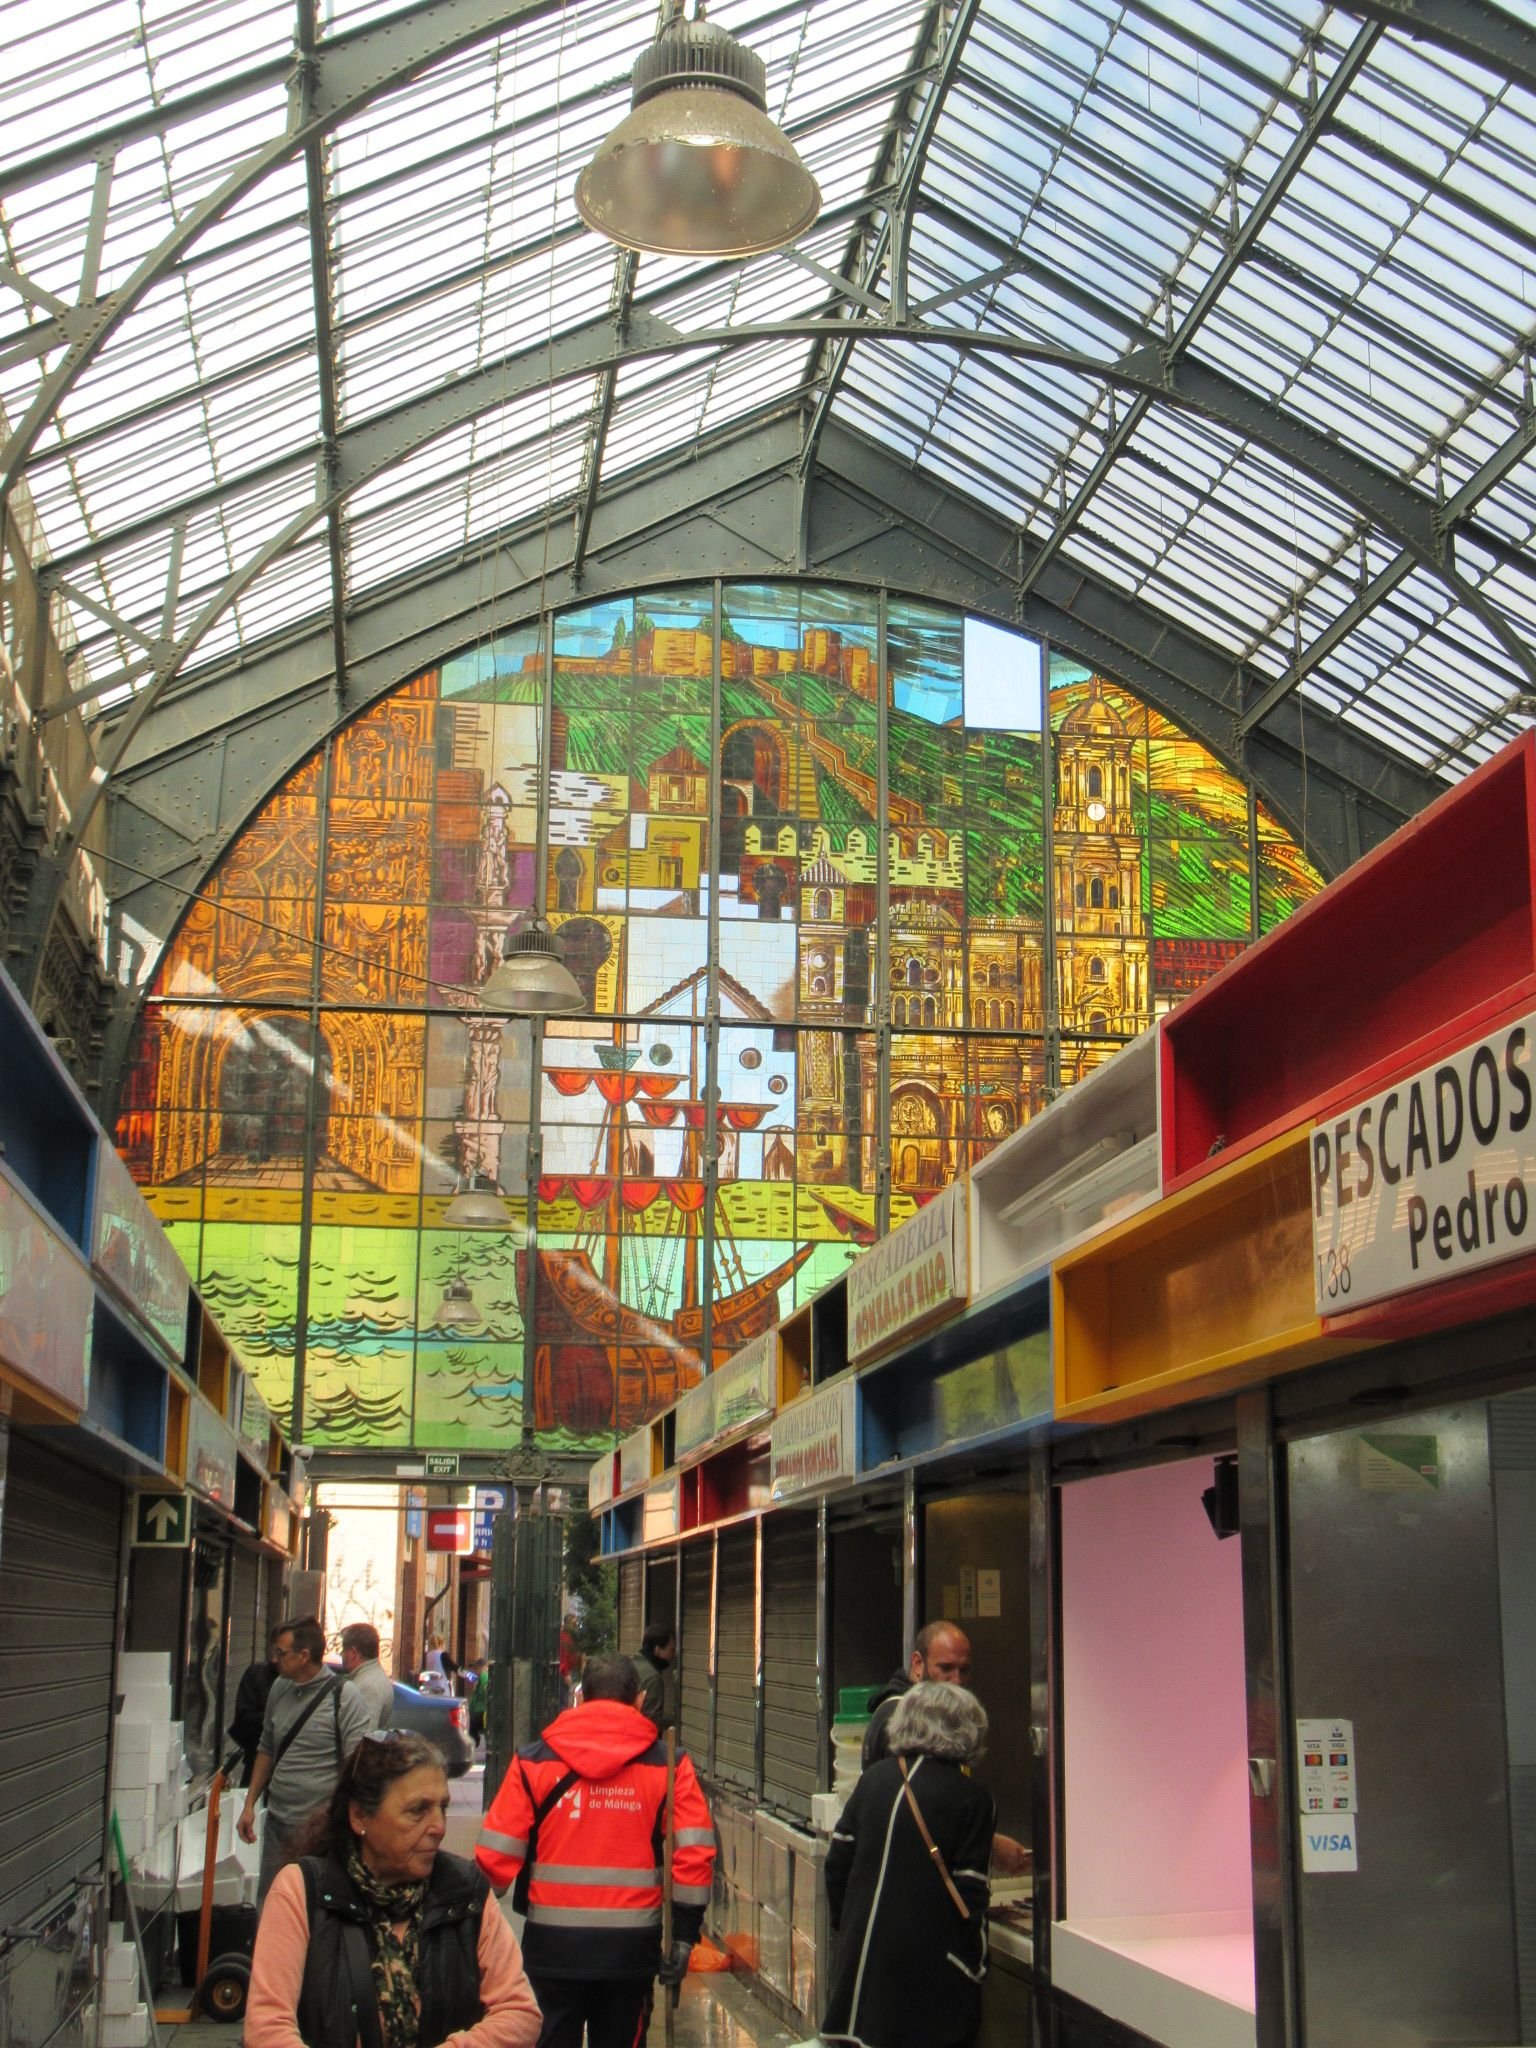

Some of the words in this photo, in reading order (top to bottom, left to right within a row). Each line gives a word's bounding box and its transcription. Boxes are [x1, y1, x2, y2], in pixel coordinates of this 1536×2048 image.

[1315, 1027, 1533, 1218] PESCADOS
[1408, 1170, 1528, 1270] Pedro
[850, 1199, 948, 1306] PESCADERIA
[1317, 1244, 1351, 1302] 138
[429, 1457, 456, 1465] SALIDA
[433, 1465, 451, 1473] EXIT
[476, 1489, 504, 1525] P
[589, 1785, 635, 1797] Limpieza
[589, 1798, 602, 1809] de
[604, 1798, 641, 1812] Málaga
[1308, 1834, 1352, 1852] VISA
